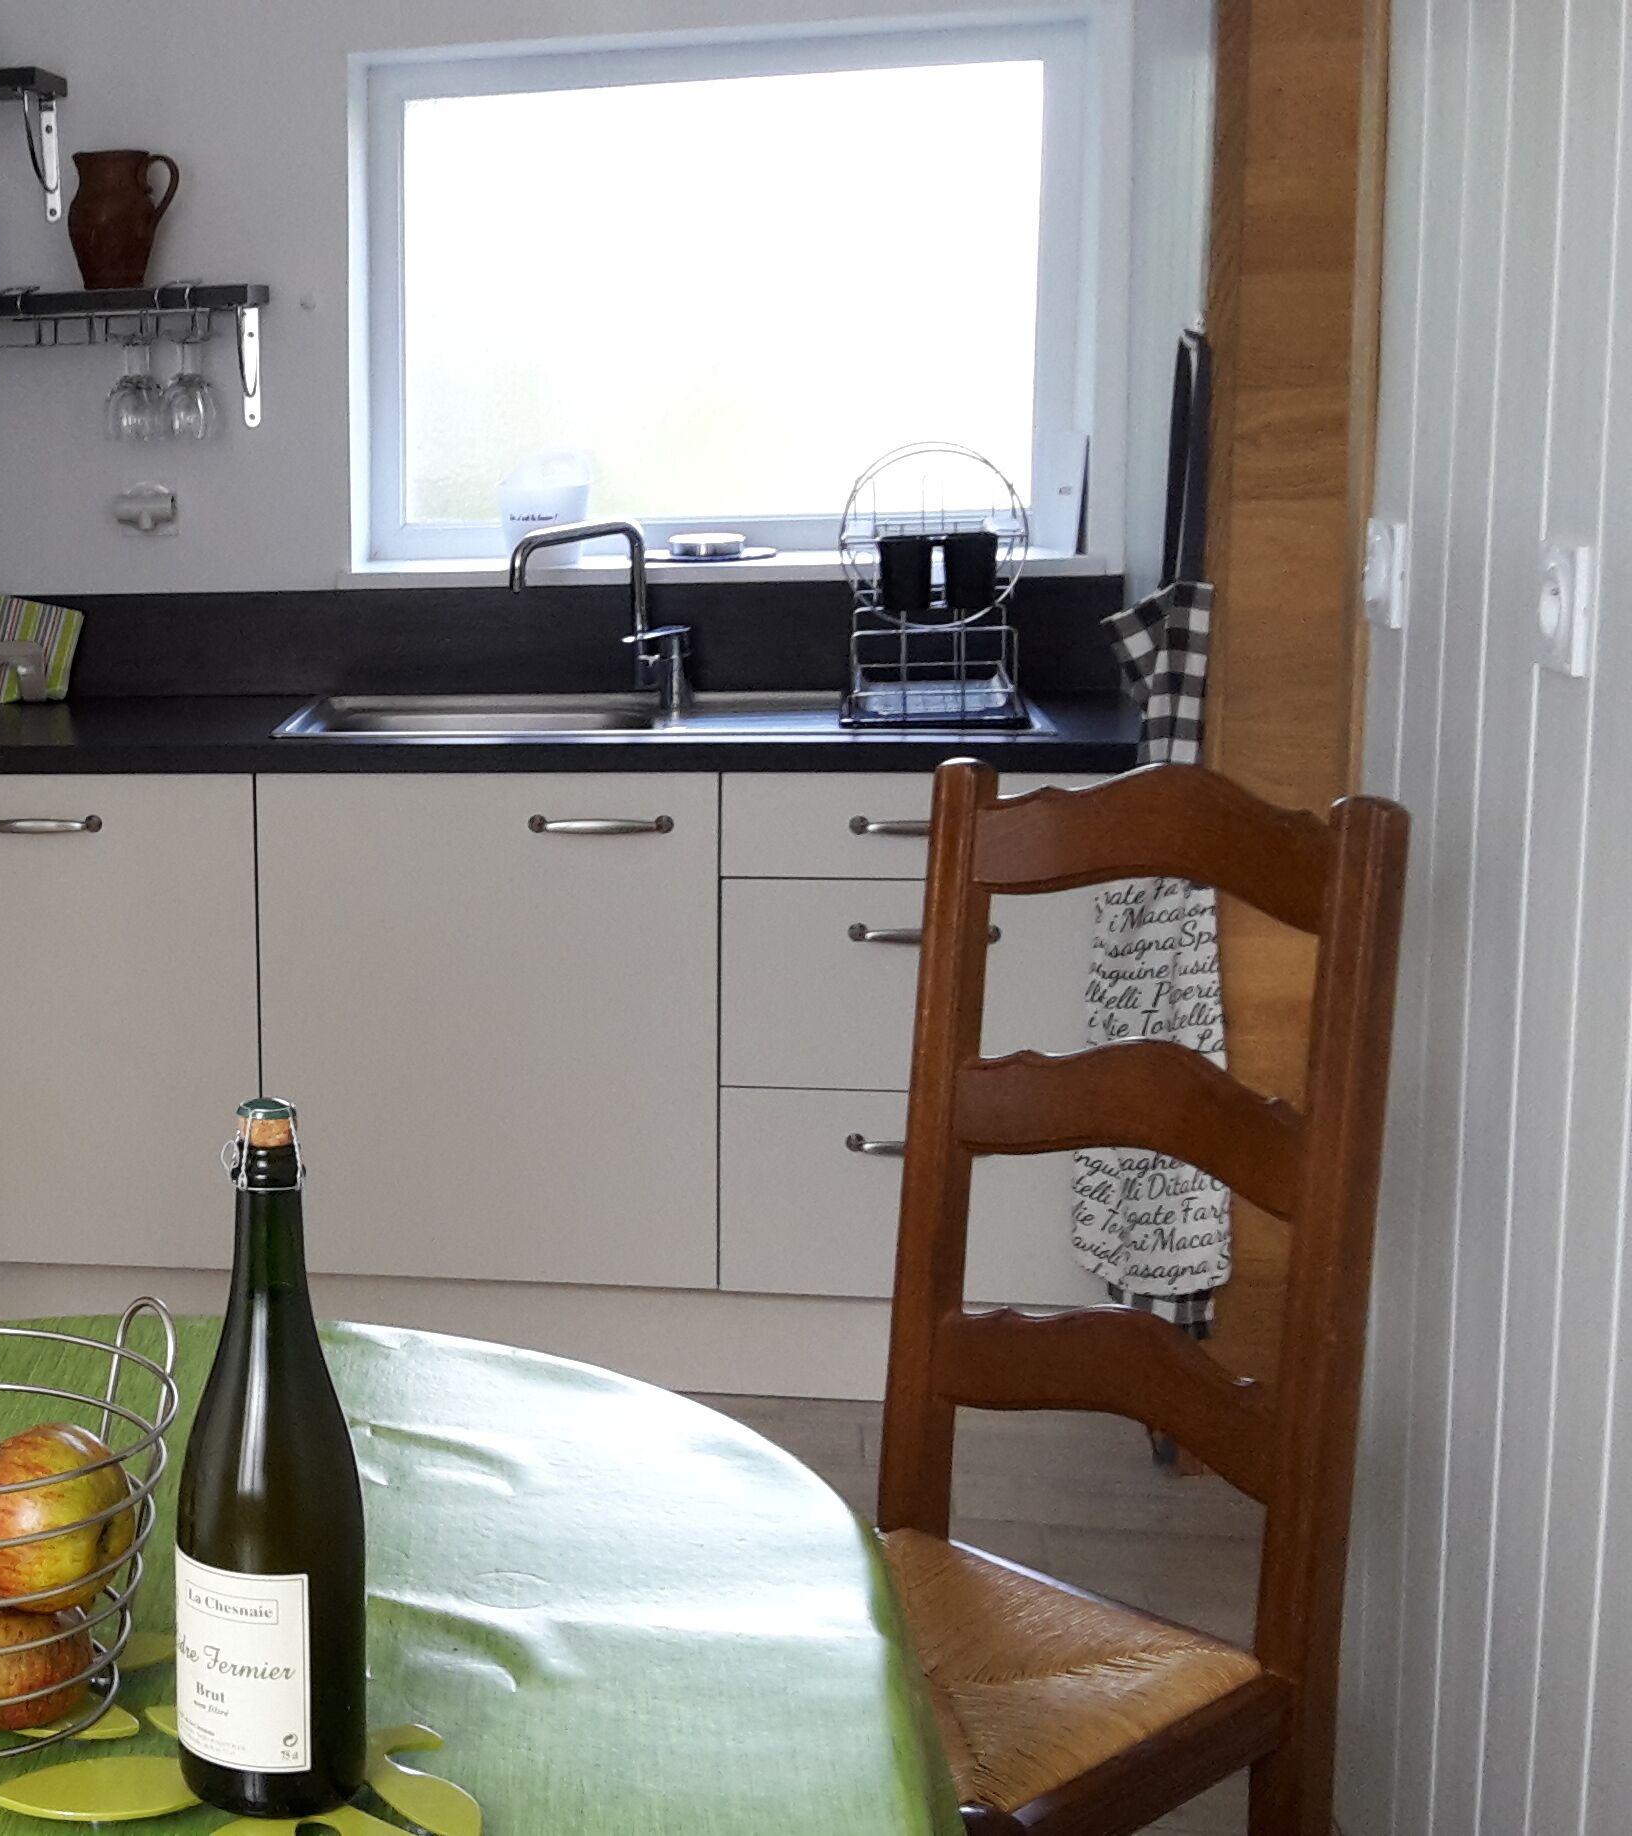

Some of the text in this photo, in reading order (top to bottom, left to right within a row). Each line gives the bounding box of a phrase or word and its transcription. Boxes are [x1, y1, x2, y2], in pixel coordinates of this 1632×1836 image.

[188, 1588, 274, 1618] La Chesnaie
[203, 1644, 296, 1681] Fermier
[196, 1681, 226, 1704] Brut
